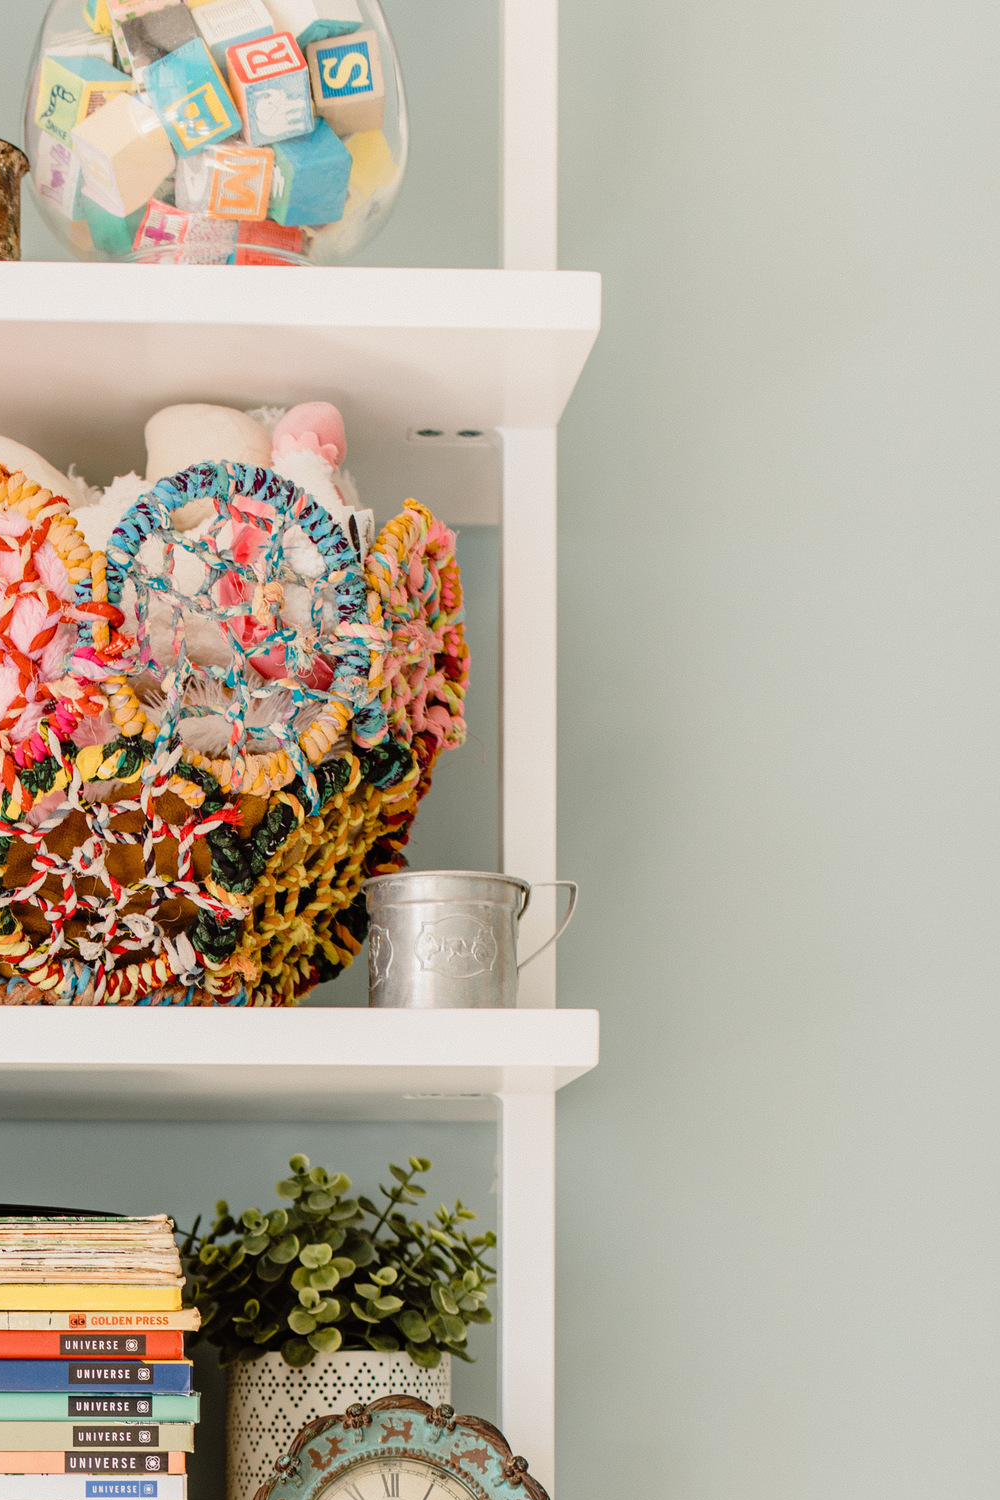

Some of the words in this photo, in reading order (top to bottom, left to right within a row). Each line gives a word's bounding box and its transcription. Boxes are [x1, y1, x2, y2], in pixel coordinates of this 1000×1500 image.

[245, 42, 293, 75] R
[321, 52, 369, 89] S
[91, 1316, 132, 1326] GOLDEN
[135, 1316, 169, 1326] PRESS
[65, 1340, 119, 1350] UNIVERSE
[70, 1458, 136, 1468] UNIVERSE
[382, 1473, 400, 1498] XII
